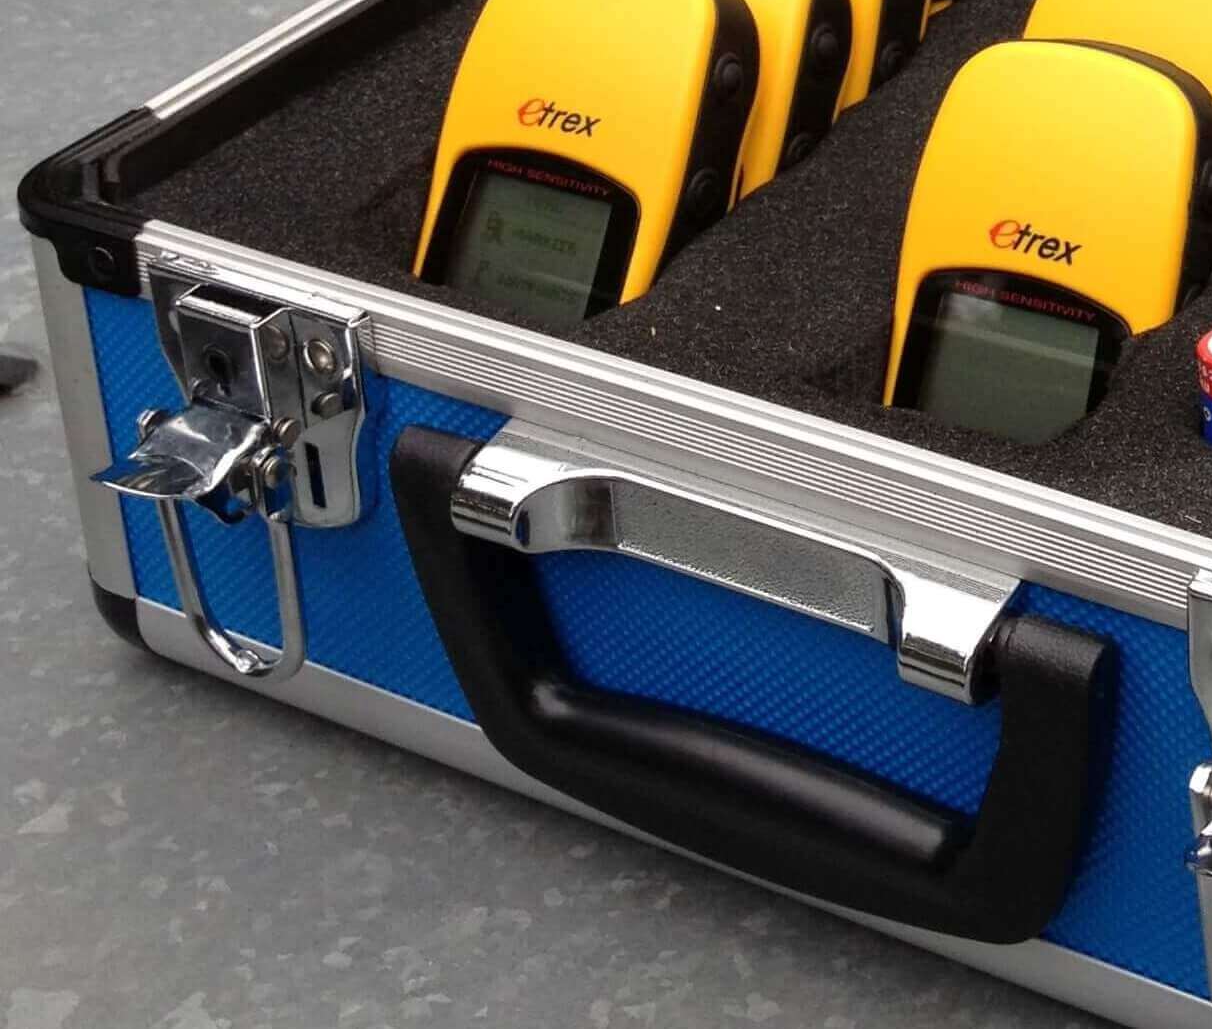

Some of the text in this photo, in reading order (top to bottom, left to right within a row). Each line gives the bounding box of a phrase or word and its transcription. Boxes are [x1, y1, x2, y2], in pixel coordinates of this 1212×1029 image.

[487, 158, 610, 196] HIGH SENSITIVITY
[955, 280, 1098, 321] HIGH SENSITIVITY
